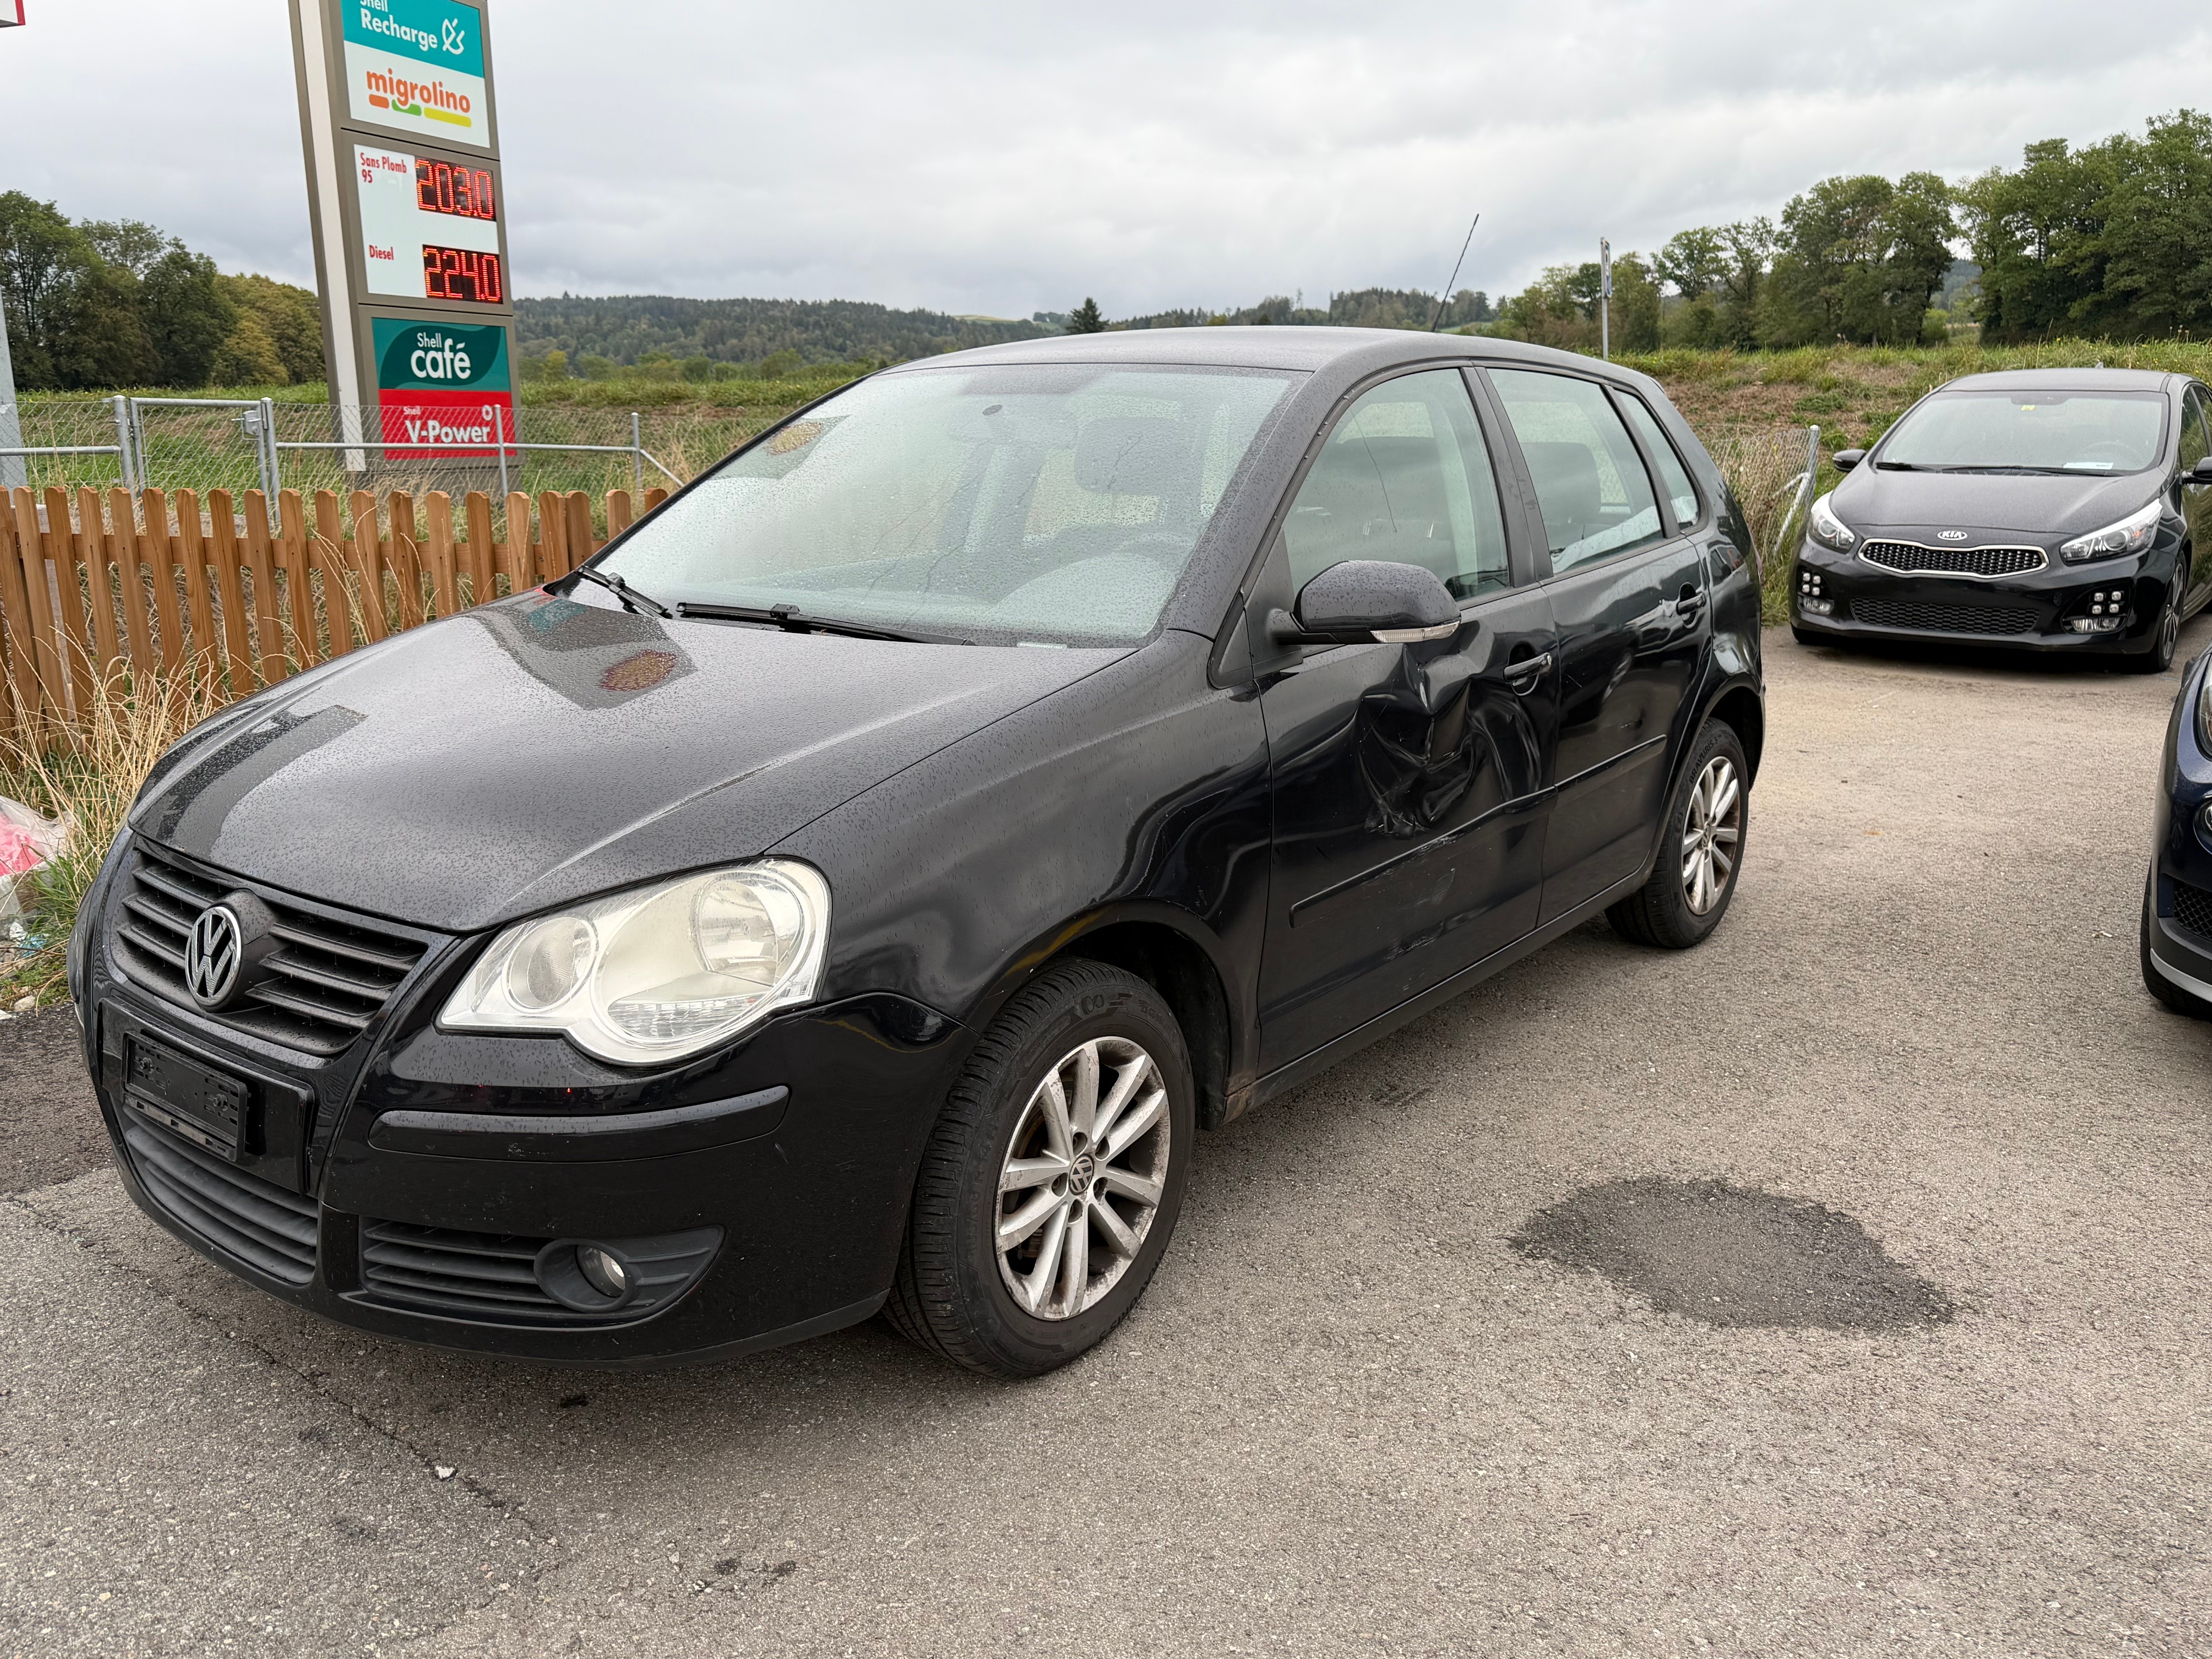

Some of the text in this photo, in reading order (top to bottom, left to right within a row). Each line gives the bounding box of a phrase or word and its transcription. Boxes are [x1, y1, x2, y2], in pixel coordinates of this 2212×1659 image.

[361, 8, 438, 52] Recharge
[366, 68, 471, 113] migrolino
[360, 152, 407, 173] Sans Plomb
[362, 169, 373, 183] 95
[369, 244, 394, 260] Diesel
[417, 332, 442, 348] Shell
[410, 338, 471, 379] café
[404, 420, 490, 443] V-Power
[1942, 531, 1963, 539] KIA
[1688, 739, 1714, 784] BRAVURIS
